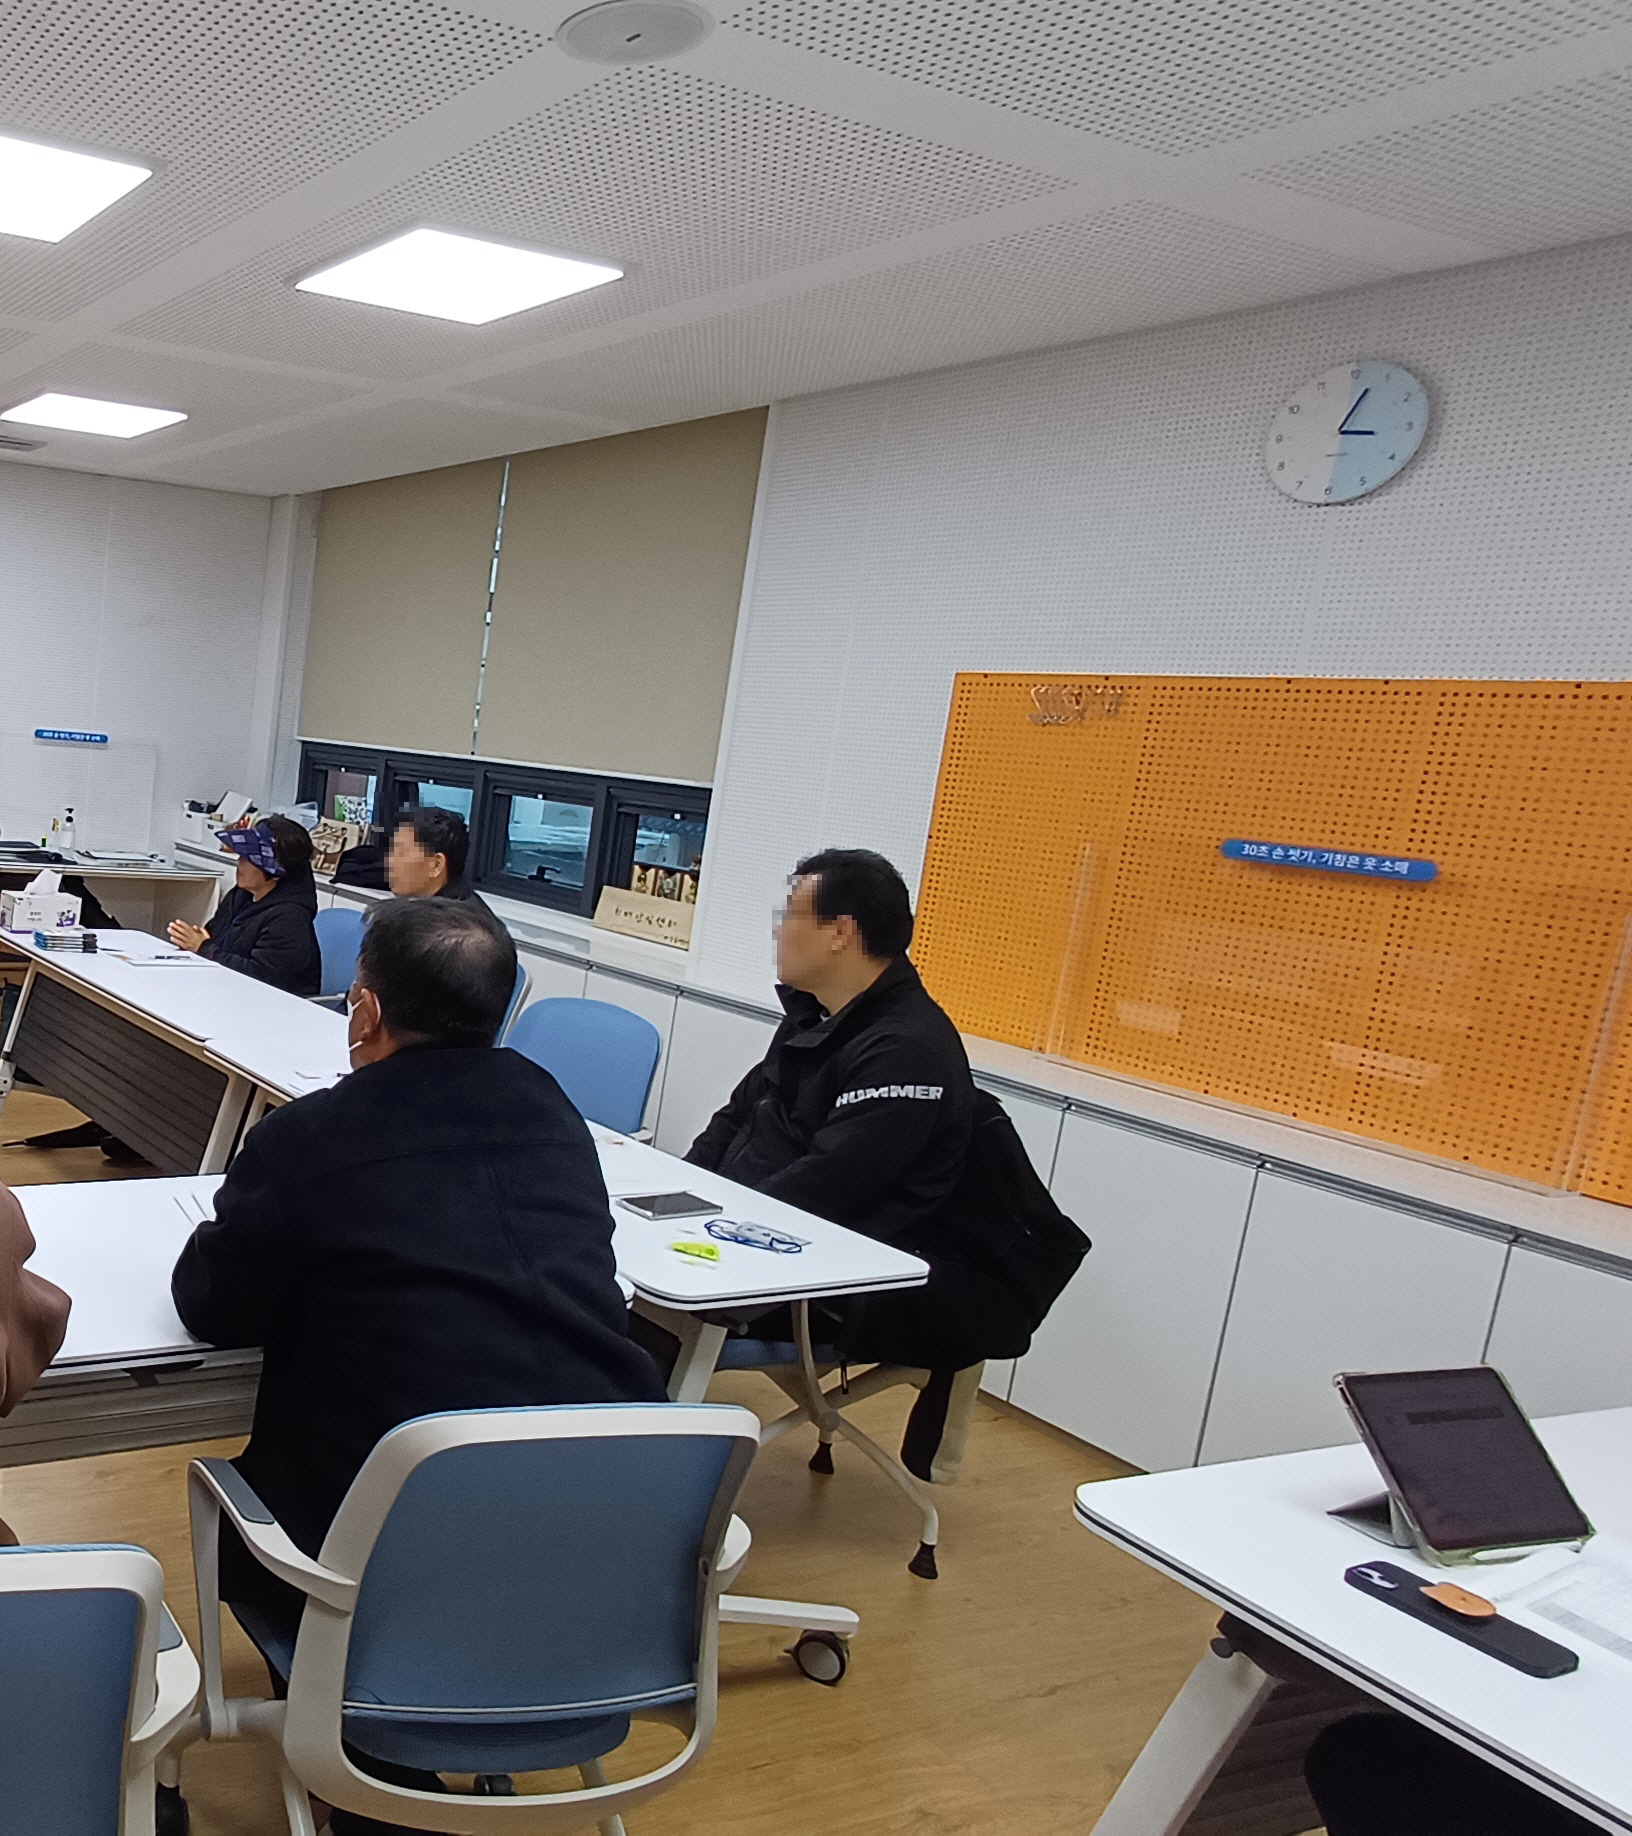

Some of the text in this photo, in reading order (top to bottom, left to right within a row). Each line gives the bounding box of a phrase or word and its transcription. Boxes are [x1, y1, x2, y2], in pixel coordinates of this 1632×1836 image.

[1240, 843, 1270, 857] 30초
[1272, 847, 1285, 860] 손
[1320, 852, 1360, 869] 기침은
[1362, 857, 1377, 872] 옷
[1379, 860, 1409, 875] 소매
[835, 1085, 944, 1108] HUMMER
